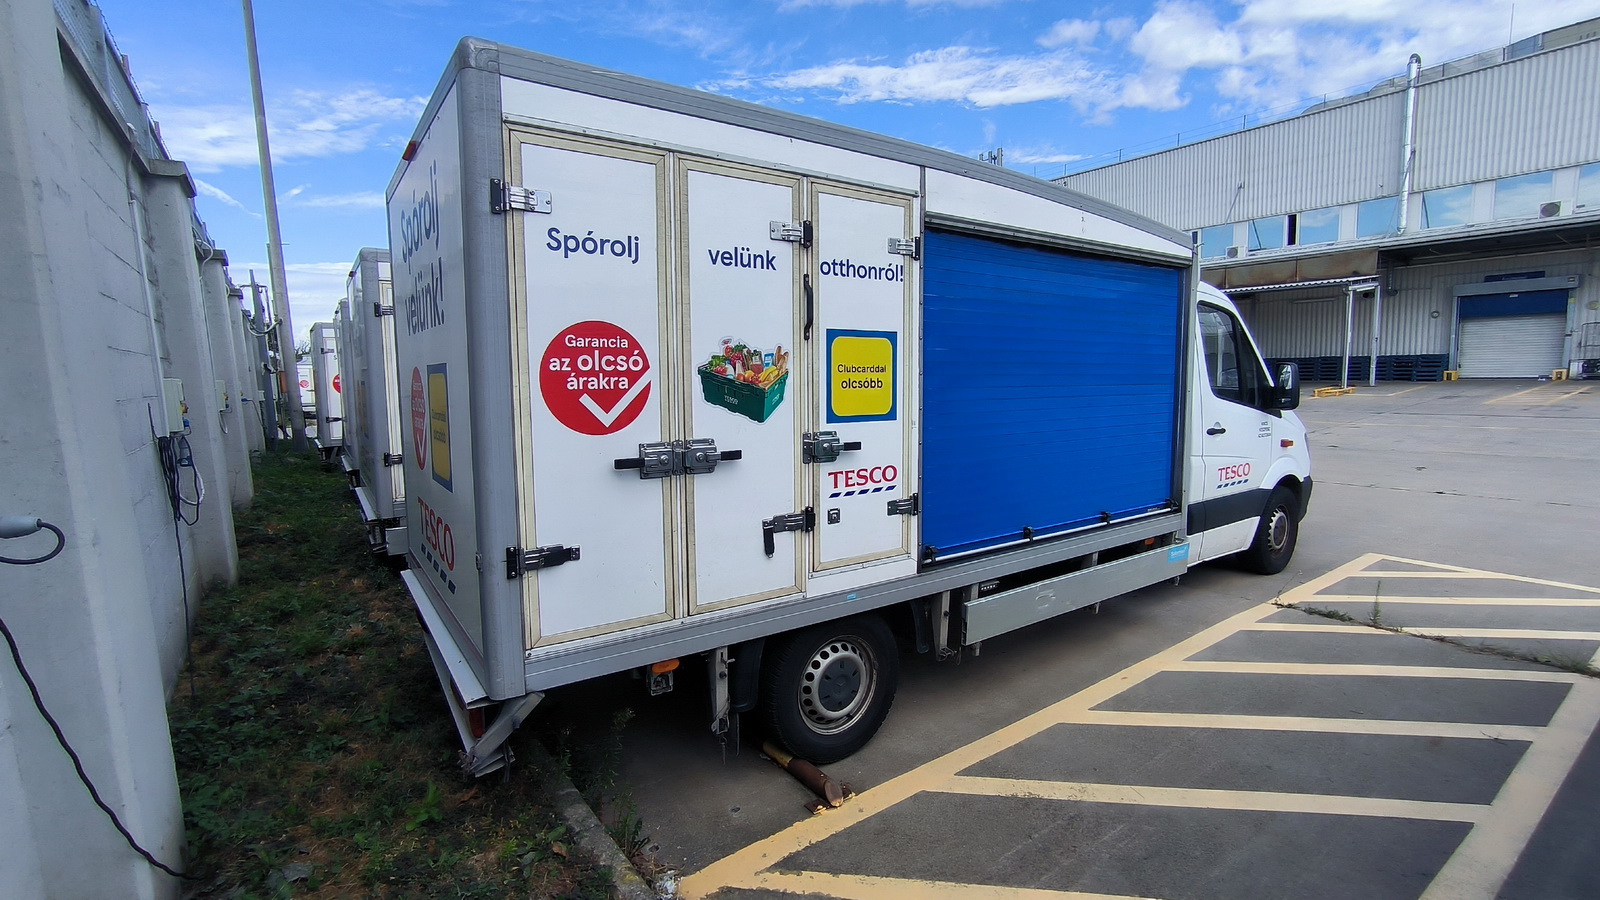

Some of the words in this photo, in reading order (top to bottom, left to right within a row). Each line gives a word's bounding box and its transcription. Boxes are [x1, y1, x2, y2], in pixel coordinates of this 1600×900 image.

[401, 159, 440, 275] Spórolj
[546, 227, 640, 265] Spórolj
[708, 246, 777, 271] velünk
[820, 258, 904, 282] otthonról!
[405, 256, 445, 337] velünk!
[564, 334, 629, 348] Garancia
[549, 357, 572, 371] az
[577, 350, 644, 372] olcsó
[837, 364, 887, 373] Clubcarddal
[566, 372, 629, 390] árakra
[841, 377, 884, 389] olcsóbb
[827, 464, 898, 489] TESCO
[1217, 462, 1251, 482] TESCO
[417, 495, 455, 572] TESCO
